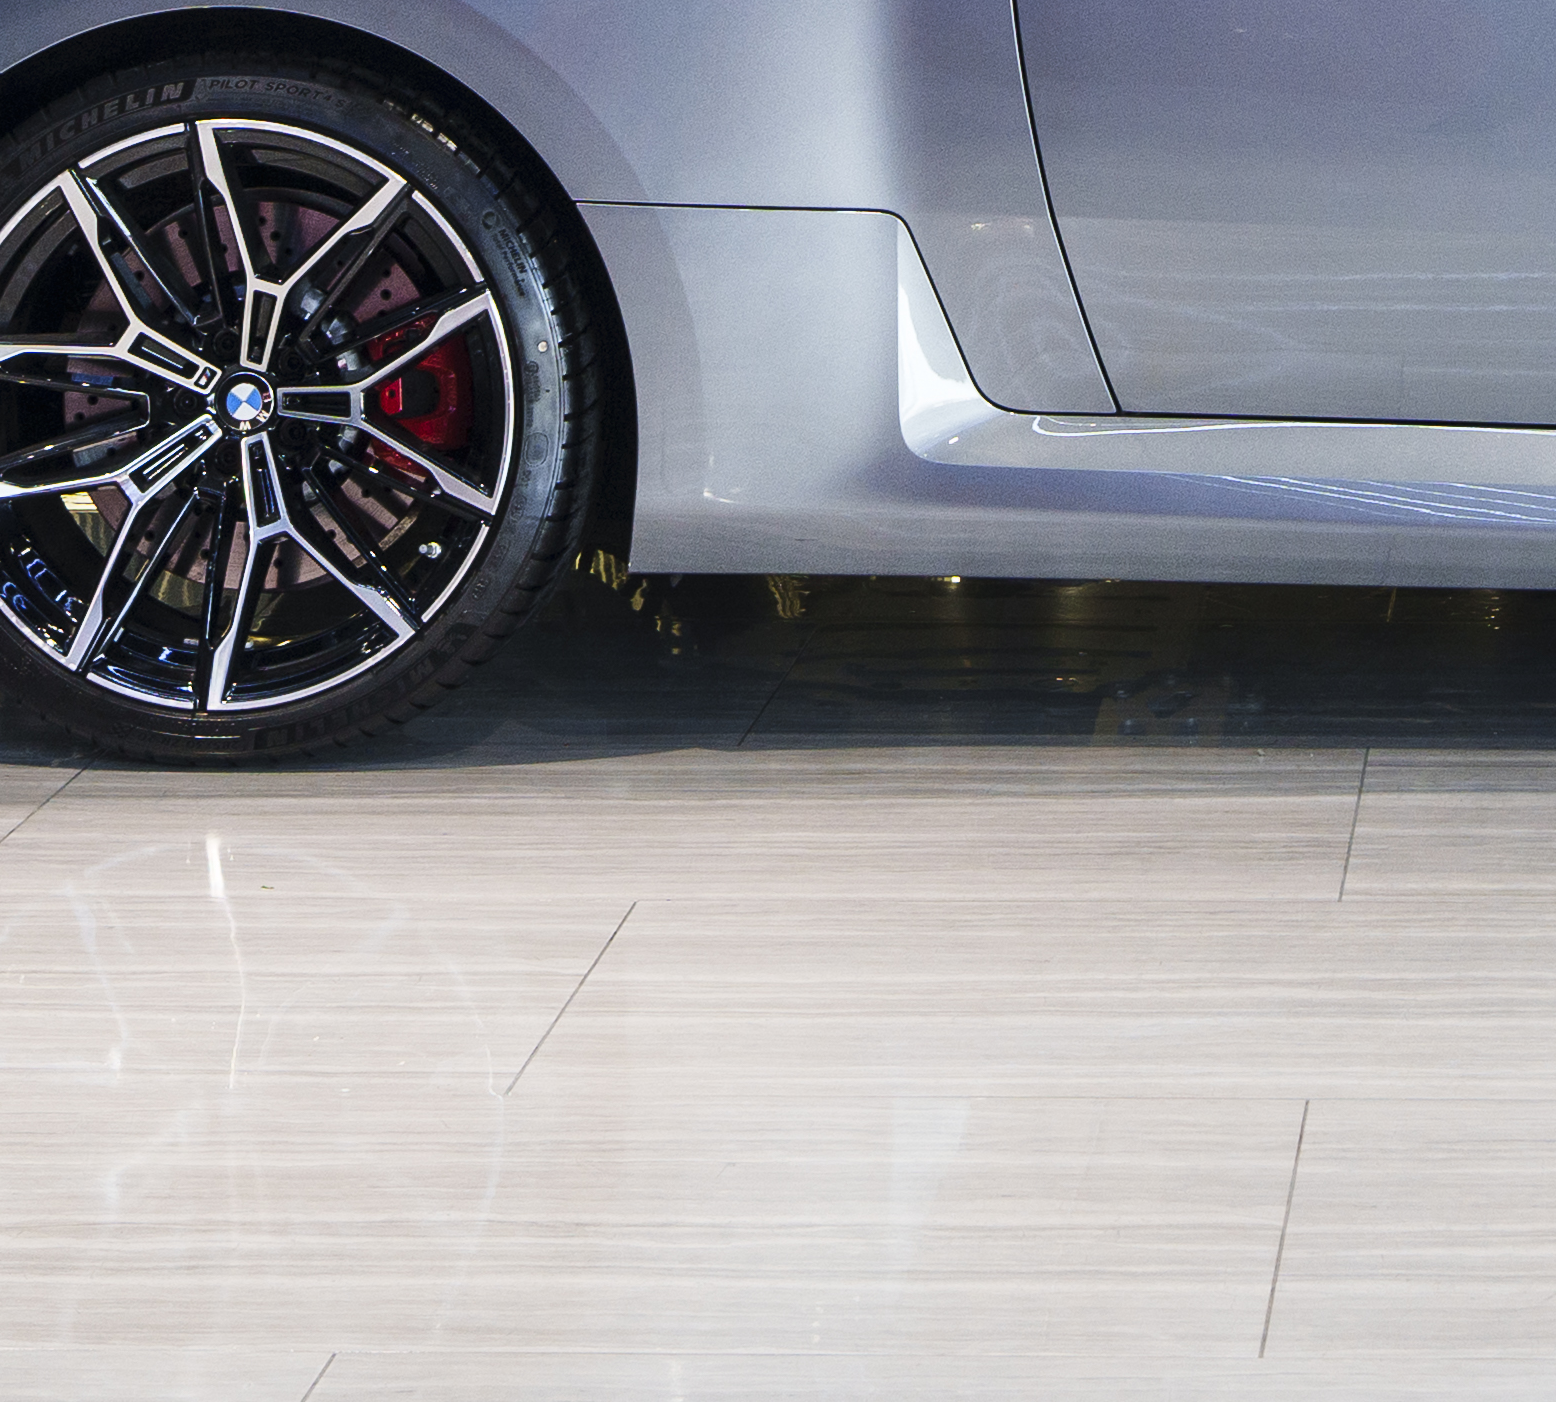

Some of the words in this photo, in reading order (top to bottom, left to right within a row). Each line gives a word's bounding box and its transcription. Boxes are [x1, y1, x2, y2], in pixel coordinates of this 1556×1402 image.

[18, 82, 185, 172] MICHELIN
[207, 78, 258, 90] PILOT
[265, 81, 324, 100] SPORT
[499, 229, 527, 274] MICHELIN
